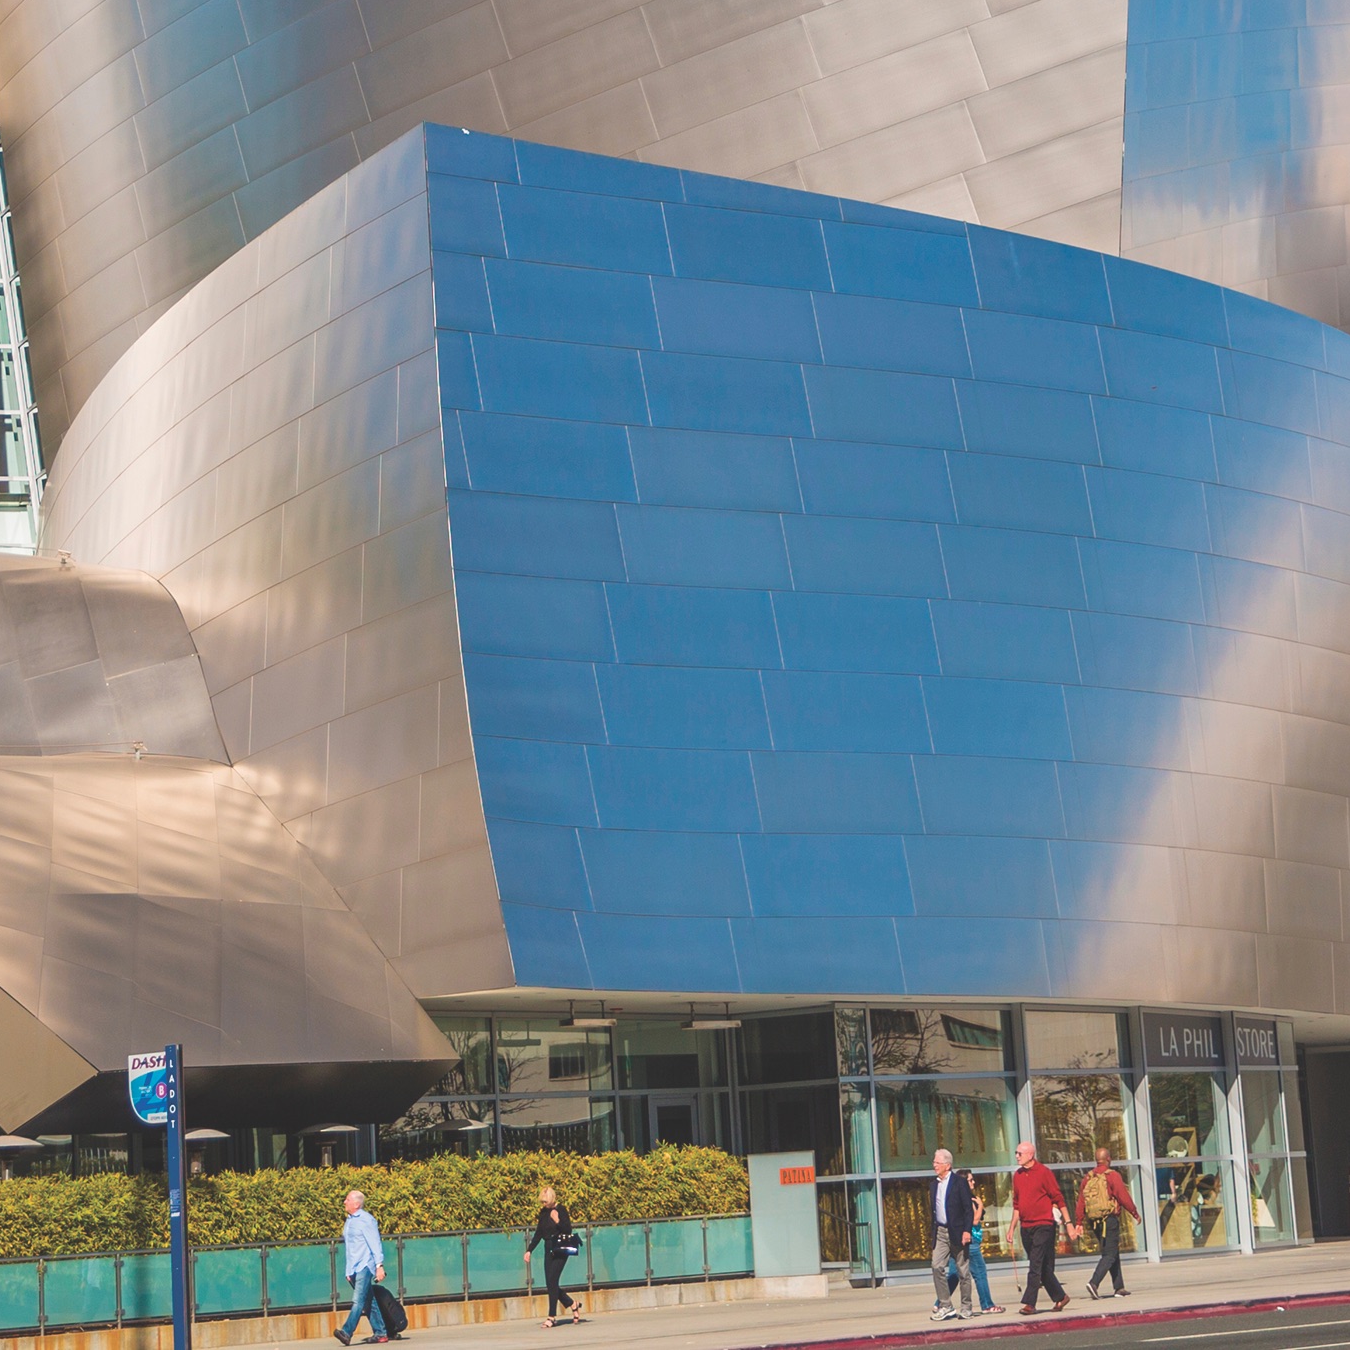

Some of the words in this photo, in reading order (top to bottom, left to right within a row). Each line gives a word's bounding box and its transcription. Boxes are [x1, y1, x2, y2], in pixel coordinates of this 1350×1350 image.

[1159, 1026, 1180, 1057] LA
[1183, 1028, 1219, 1058] PHIL
[1236, 1027, 1276, 1059] STORE
[158, 1085, 165, 1097] B
[168, 1059, 177, 1129] LADOT
[782, 1169, 812, 1184] PATINA
